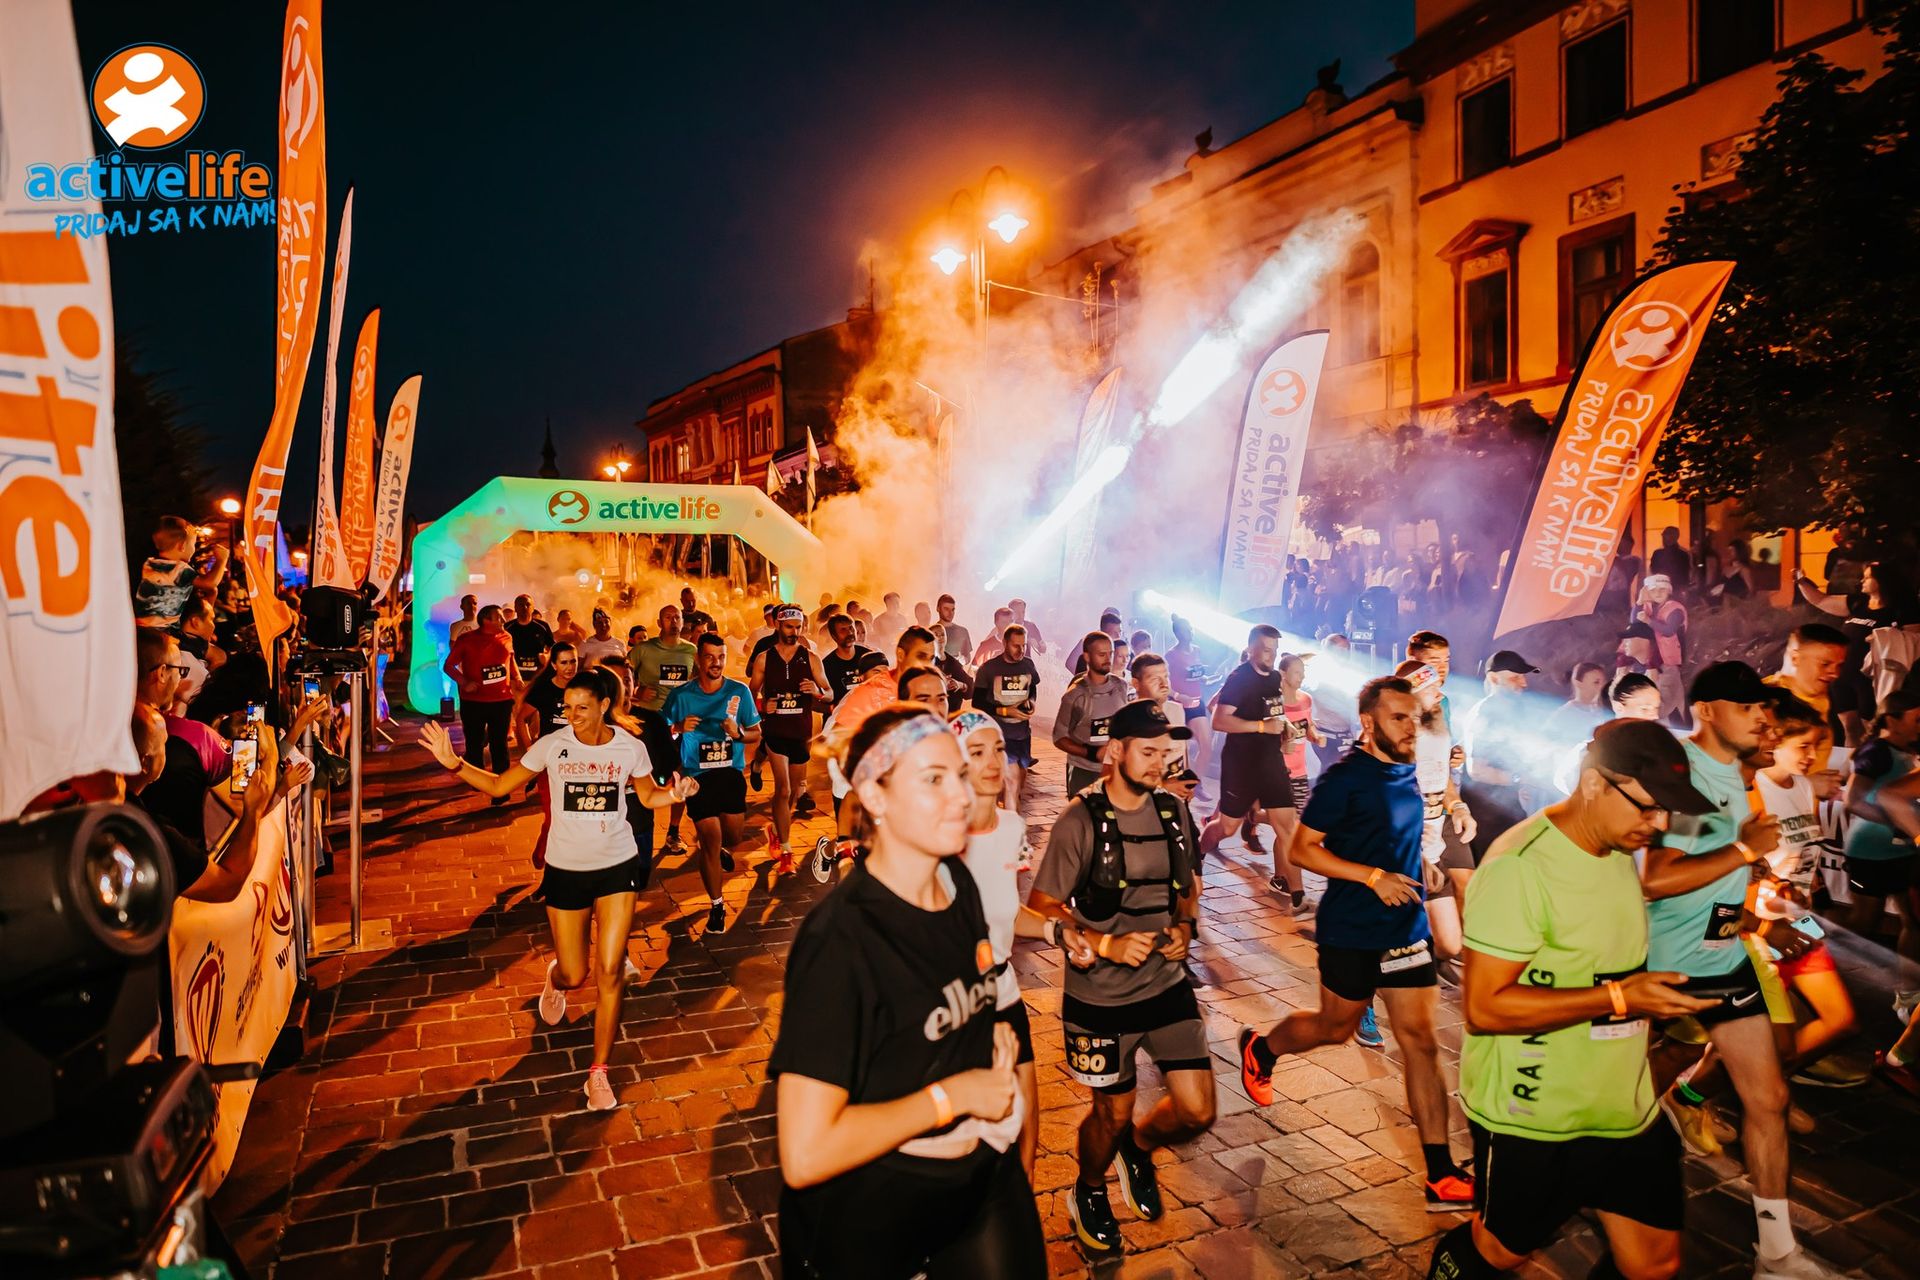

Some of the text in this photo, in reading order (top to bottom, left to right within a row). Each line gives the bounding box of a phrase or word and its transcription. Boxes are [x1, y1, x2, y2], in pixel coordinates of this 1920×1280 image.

[1565, 379, 1609, 456] PRIDAJ
[1242, 426, 1263, 484] PRIDAJ
[1553, 460, 1580, 487] SA
[600, 496, 721, 520] activelife
[1238, 488, 1253, 508] SA
[1548, 494, 1571, 512] K
[1237, 514, 1250, 526] K
[1251, 433, 1291, 587] activelife
[667, 672, 682, 680] 187
[781, 700, 797, 708] 110
[707, 751, 727, 761] 586
[576, 796, 607, 811] 182
[1508, 968, 1556, 1116] TRAIG
[1071, 1051, 1106, 1073] 390
